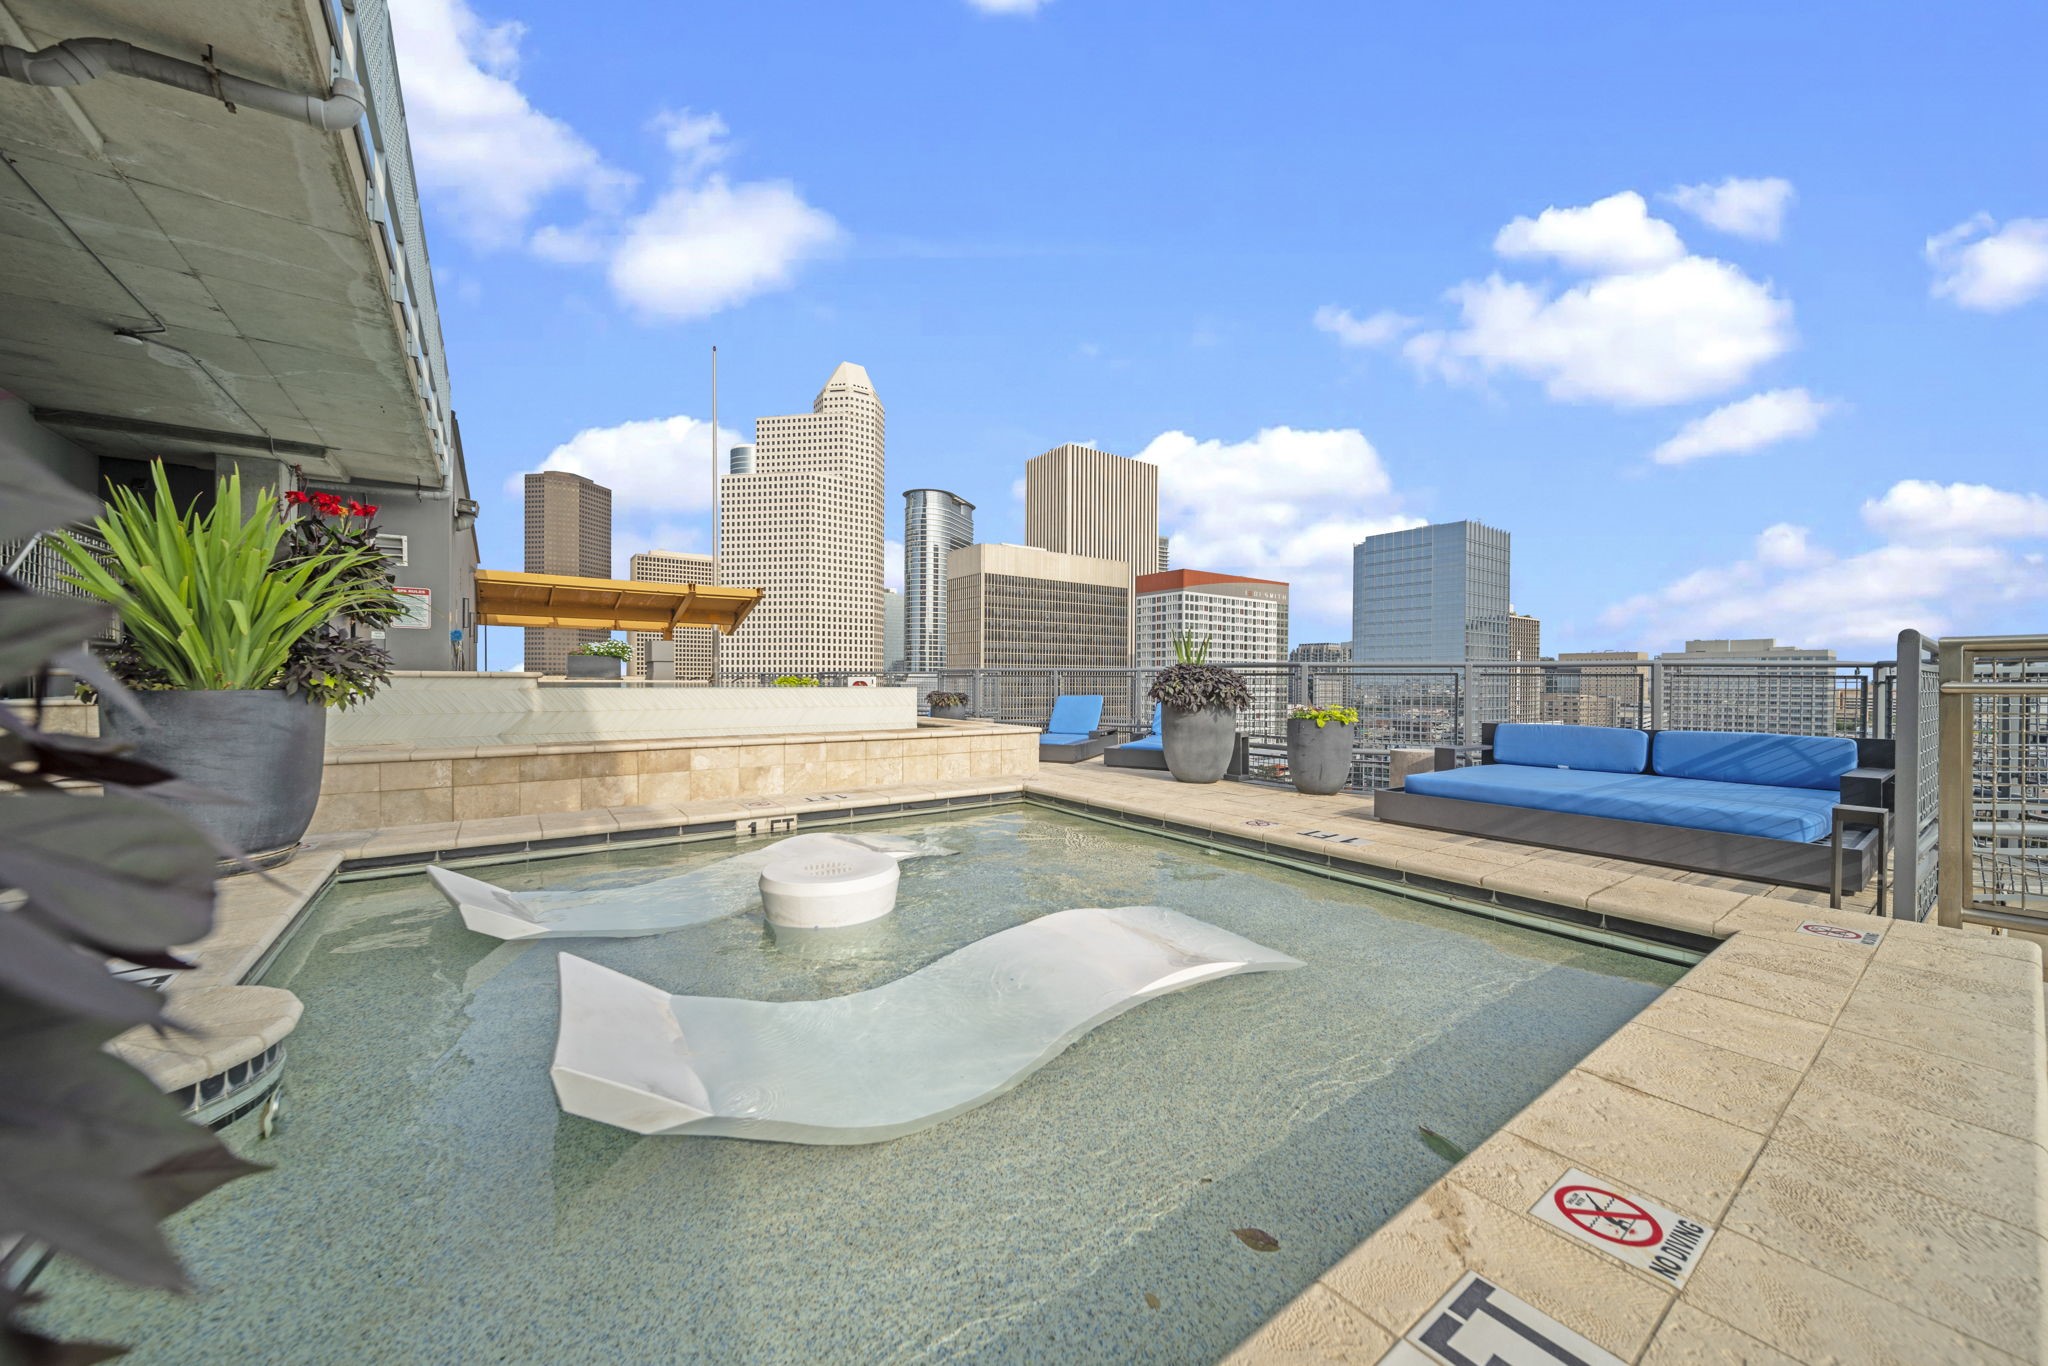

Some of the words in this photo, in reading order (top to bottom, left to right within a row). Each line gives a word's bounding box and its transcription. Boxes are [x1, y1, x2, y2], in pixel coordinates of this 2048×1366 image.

[748, 822, 757, 834] 1
[1661, 1219, 1704, 1262] DIVING
[1649, 1255, 1682, 1281] NO
